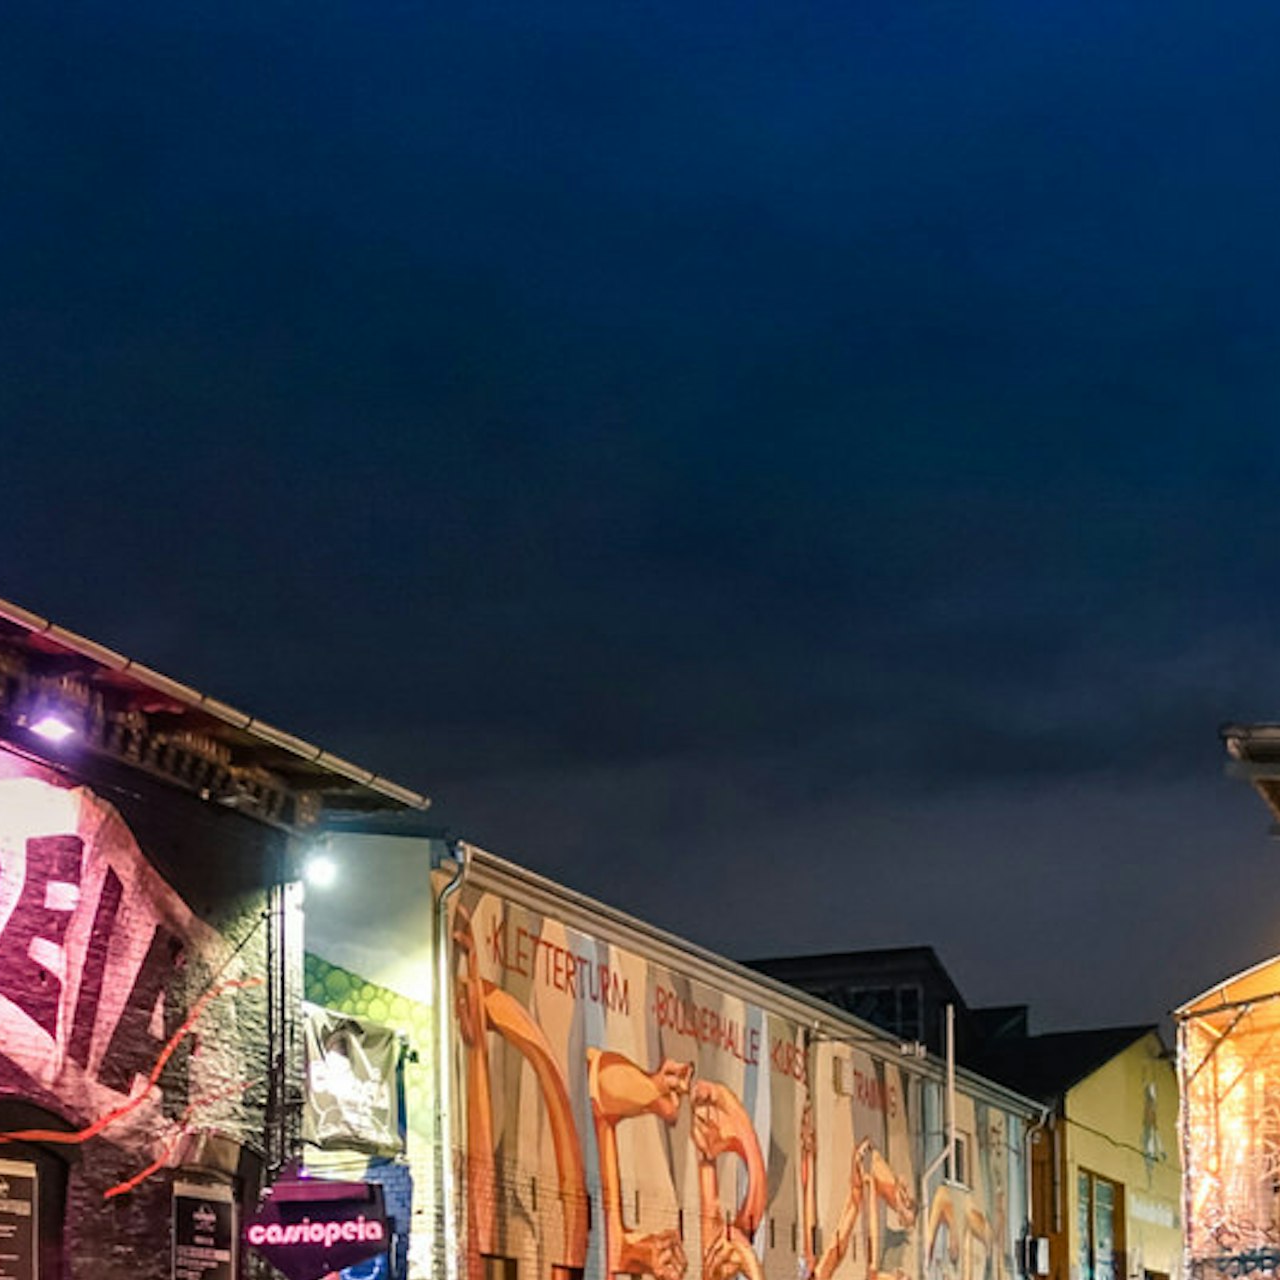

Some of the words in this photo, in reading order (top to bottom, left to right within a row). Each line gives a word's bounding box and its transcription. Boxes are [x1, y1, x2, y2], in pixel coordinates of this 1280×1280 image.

[492, 914, 630, 1017] KLETTERTURM
[655, 985, 760, 1067] BOULDERHALLE
[248, 1215, 382, 1247] cassiopeia
